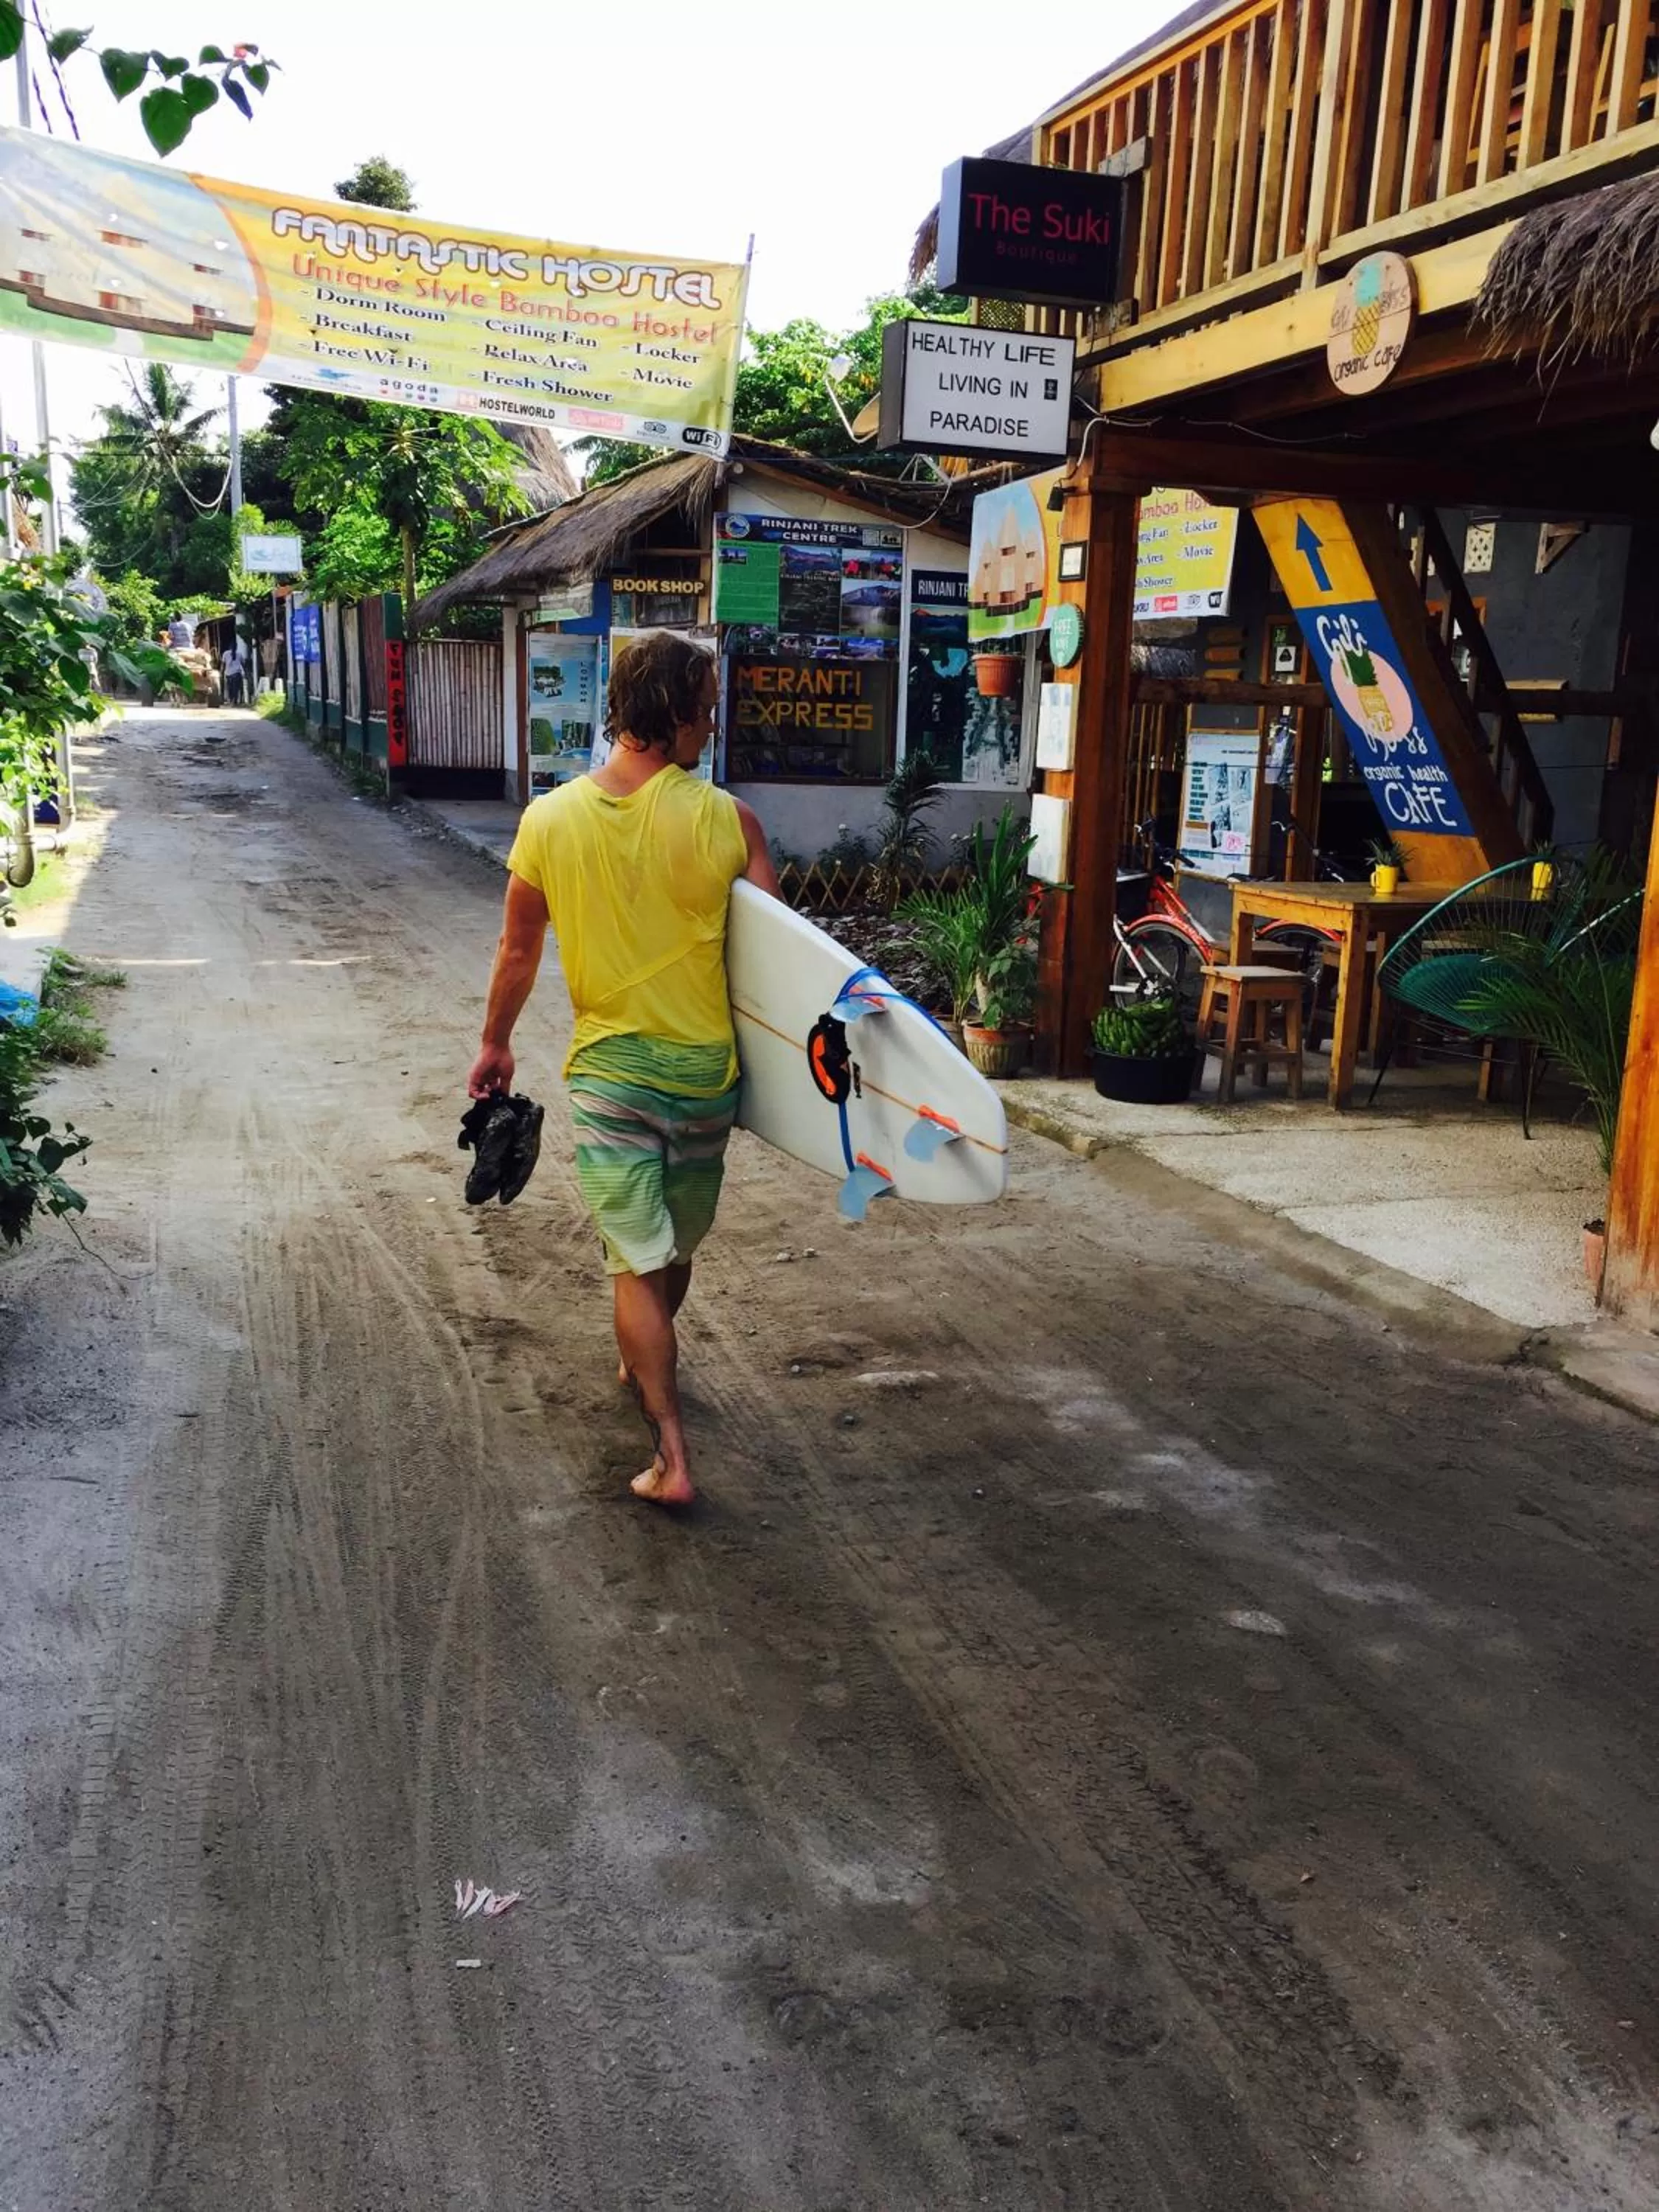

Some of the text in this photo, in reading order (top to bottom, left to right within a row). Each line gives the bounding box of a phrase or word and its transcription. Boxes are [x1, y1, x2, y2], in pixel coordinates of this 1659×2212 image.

[968, 194, 1111, 246] The Suki
[272, 207, 722, 310] FANTASTIC HOSTEL
[995, 240, 1077, 266] Boutique
[293, 253, 717, 346] Unique Style Bamboo Hostel
[316, 288, 446, 322] Dorm Room
[316, 313, 413, 343] Breakfast
[485, 319, 598, 349] Ceiling Fan
[313, 340, 430, 372] Free Wi-Fi
[485, 344, 588, 373] Relax Area
[636, 343, 701, 366] Locker
[912, 332, 1055, 367] HEALTHY LIFE
[379, 378, 439, 395] agoda
[482, 371, 614, 403] Fresh Shower
[633, 368, 695, 390] Movie
[939, 372, 1001, 396] LIVING
[1009, 380, 1029, 399] IN
[479, 397, 555, 420] HOSTELWORLD
[930, 411, 1029, 437] PARADISE
[1139, 498, 1179, 520] mboo
[761, 518, 858, 535] RINJANI TREK
[782, 531, 838, 543] CENTRE
[1185, 519, 1218, 534] Locker
[1183, 545, 1214, 557] Movie
[613, 578, 705, 594] BOOK SHOP
[918, 579, 956, 597] RINJANI
[1144, 576, 1173, 588] Shower
[1316, 613, 1368, 686] Gili
[737, 665, 862, 697] MERANTI
[738, 700, 874, 731] EXPRESS
[1363, 762, 1449, 782] organic health
[1385, 782, 1458, 827] CAFE
